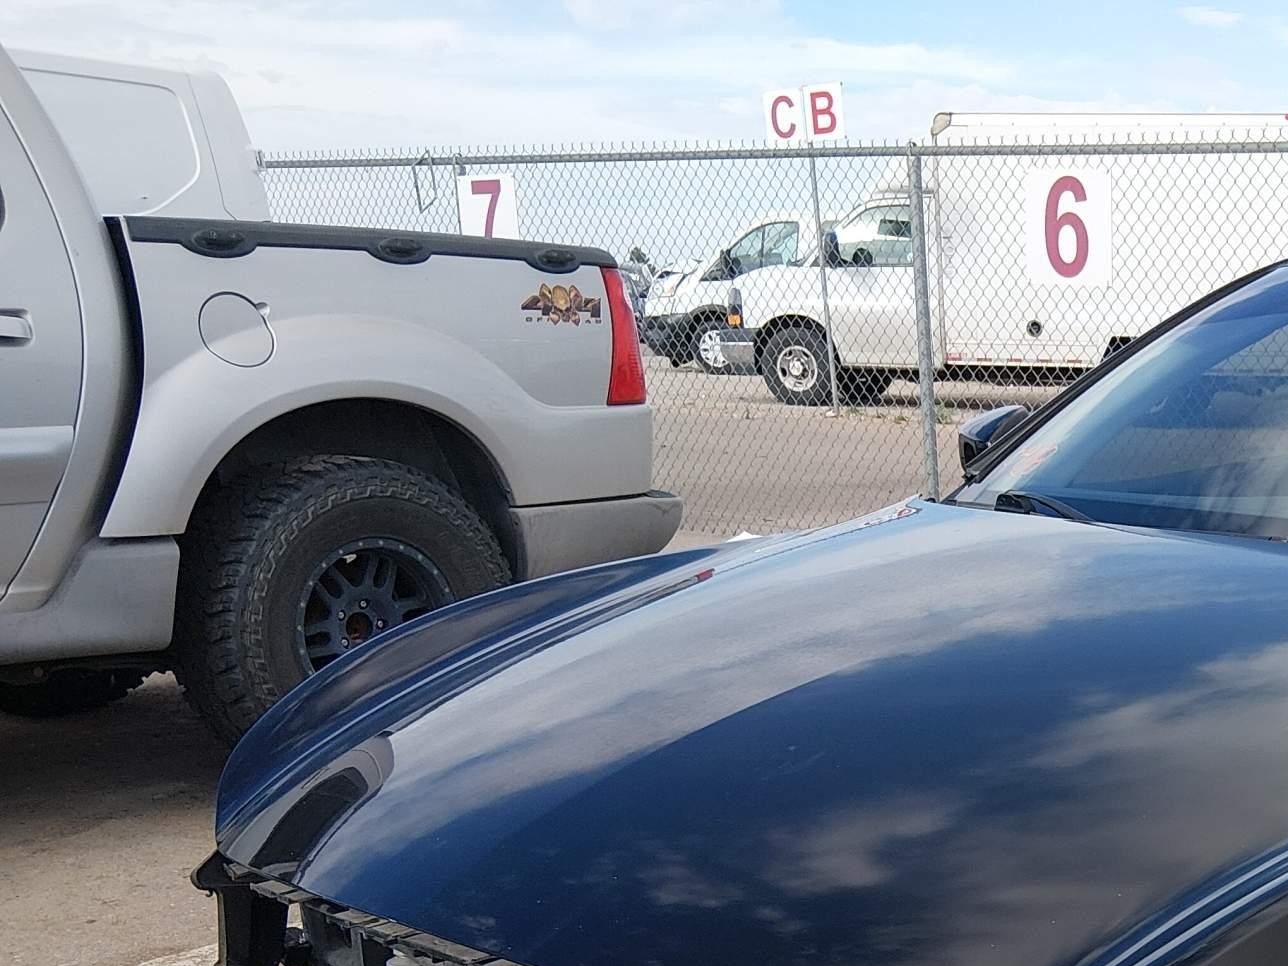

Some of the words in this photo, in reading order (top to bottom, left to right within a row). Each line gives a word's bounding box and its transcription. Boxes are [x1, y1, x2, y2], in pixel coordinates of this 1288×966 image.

[770, 94, 798, 138] C
[810, 91, 838, 135] B
[471, 179, 502, 238] 7
[1045, 175, 1089, 278] 6
